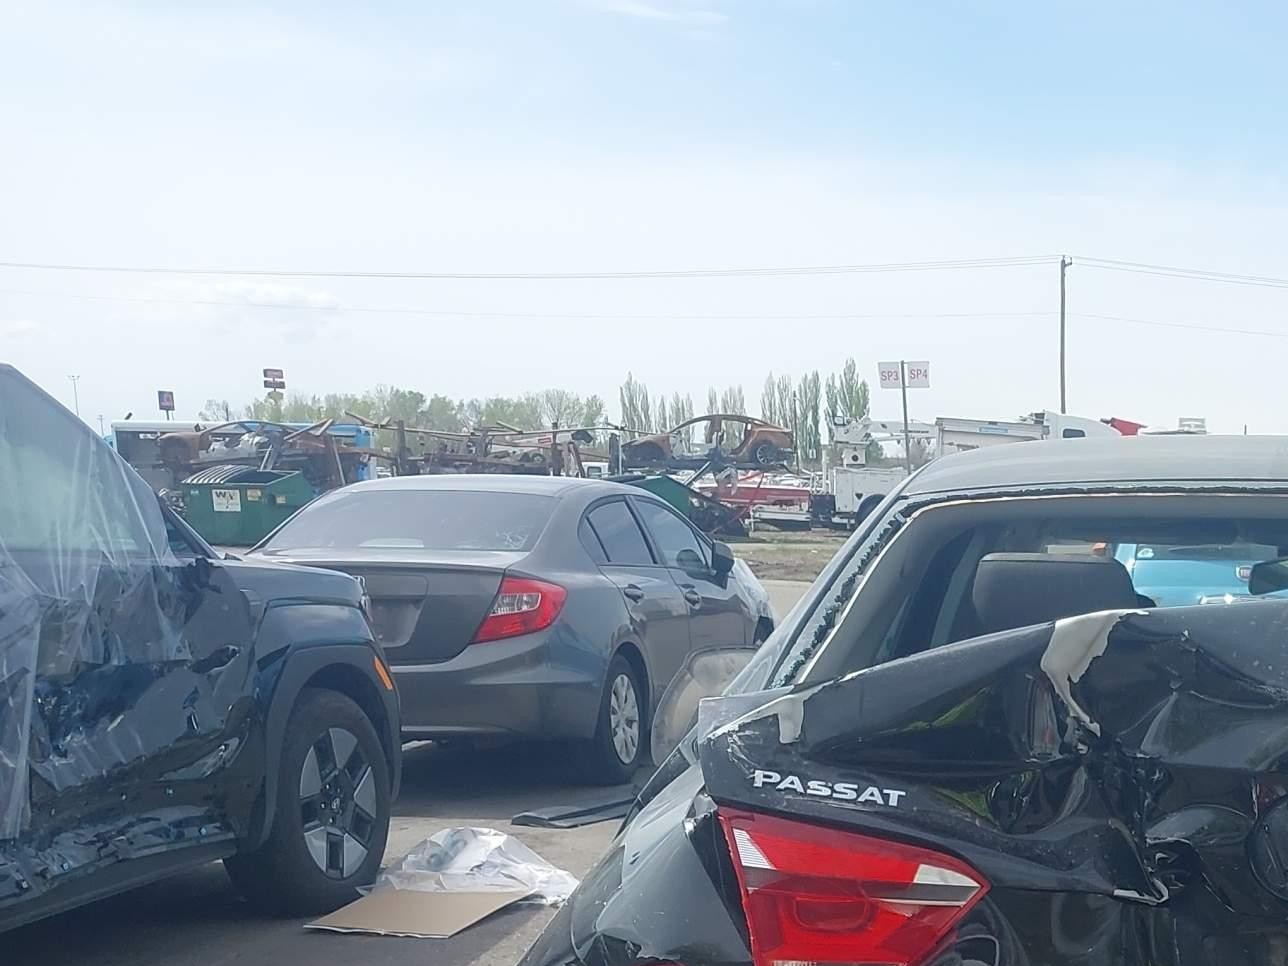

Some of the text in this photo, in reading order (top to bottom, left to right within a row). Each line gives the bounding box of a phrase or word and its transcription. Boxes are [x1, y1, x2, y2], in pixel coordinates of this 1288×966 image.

[881, 370, 899, 381] SP3
[910, 368, 928, 380] SP4
[752, 769, 906, 807] PASSAT
